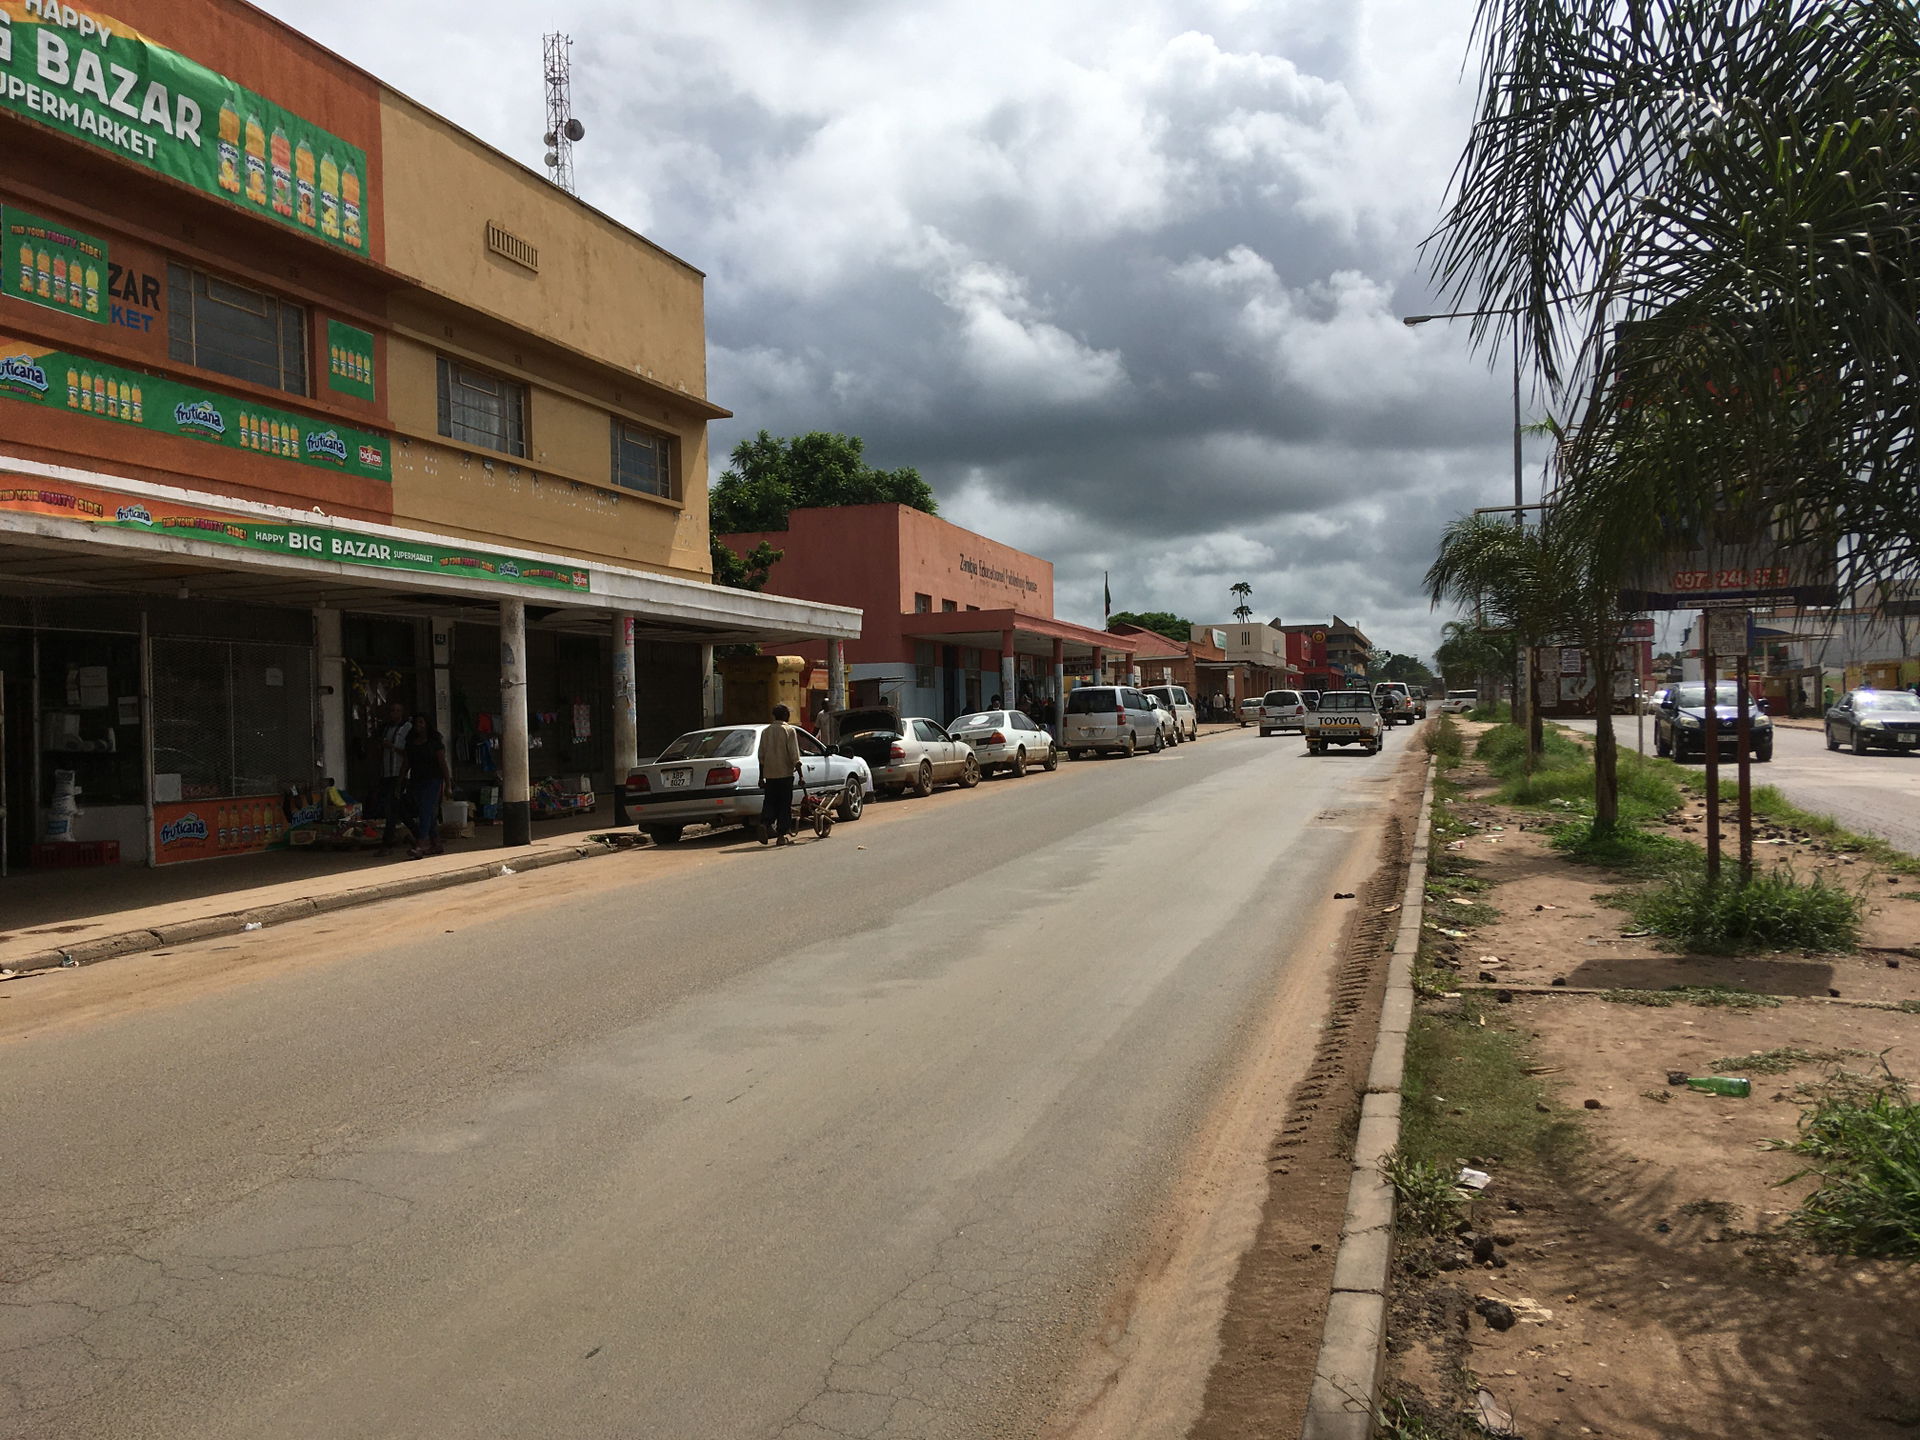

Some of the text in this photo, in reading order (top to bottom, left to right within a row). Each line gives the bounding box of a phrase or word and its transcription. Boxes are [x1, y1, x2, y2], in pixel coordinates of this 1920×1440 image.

[25, 0, 112, 48] HAPPY
[37, 27, 202, 148] BAZAR
[175, 405, 222, 428] fruticana
[306, 434, 345, 455] fruticana
[16, 489, 39, 502] YOUR
[40, 490, 76, 509] FRUITY
[77, 498, 104, 518] SIDE!
[116, 507, 151, 522] fruticana
[195, 518, 225, 533] FRUITY
[226, 524, 248, 541] SIDE!
[255, 531, 434, 564] HAPPY BIG BAZAR SUPERMARKET
[1318, 717, 1360, 725] TOYOTA
[161, 820, 205, 842] fruticana
